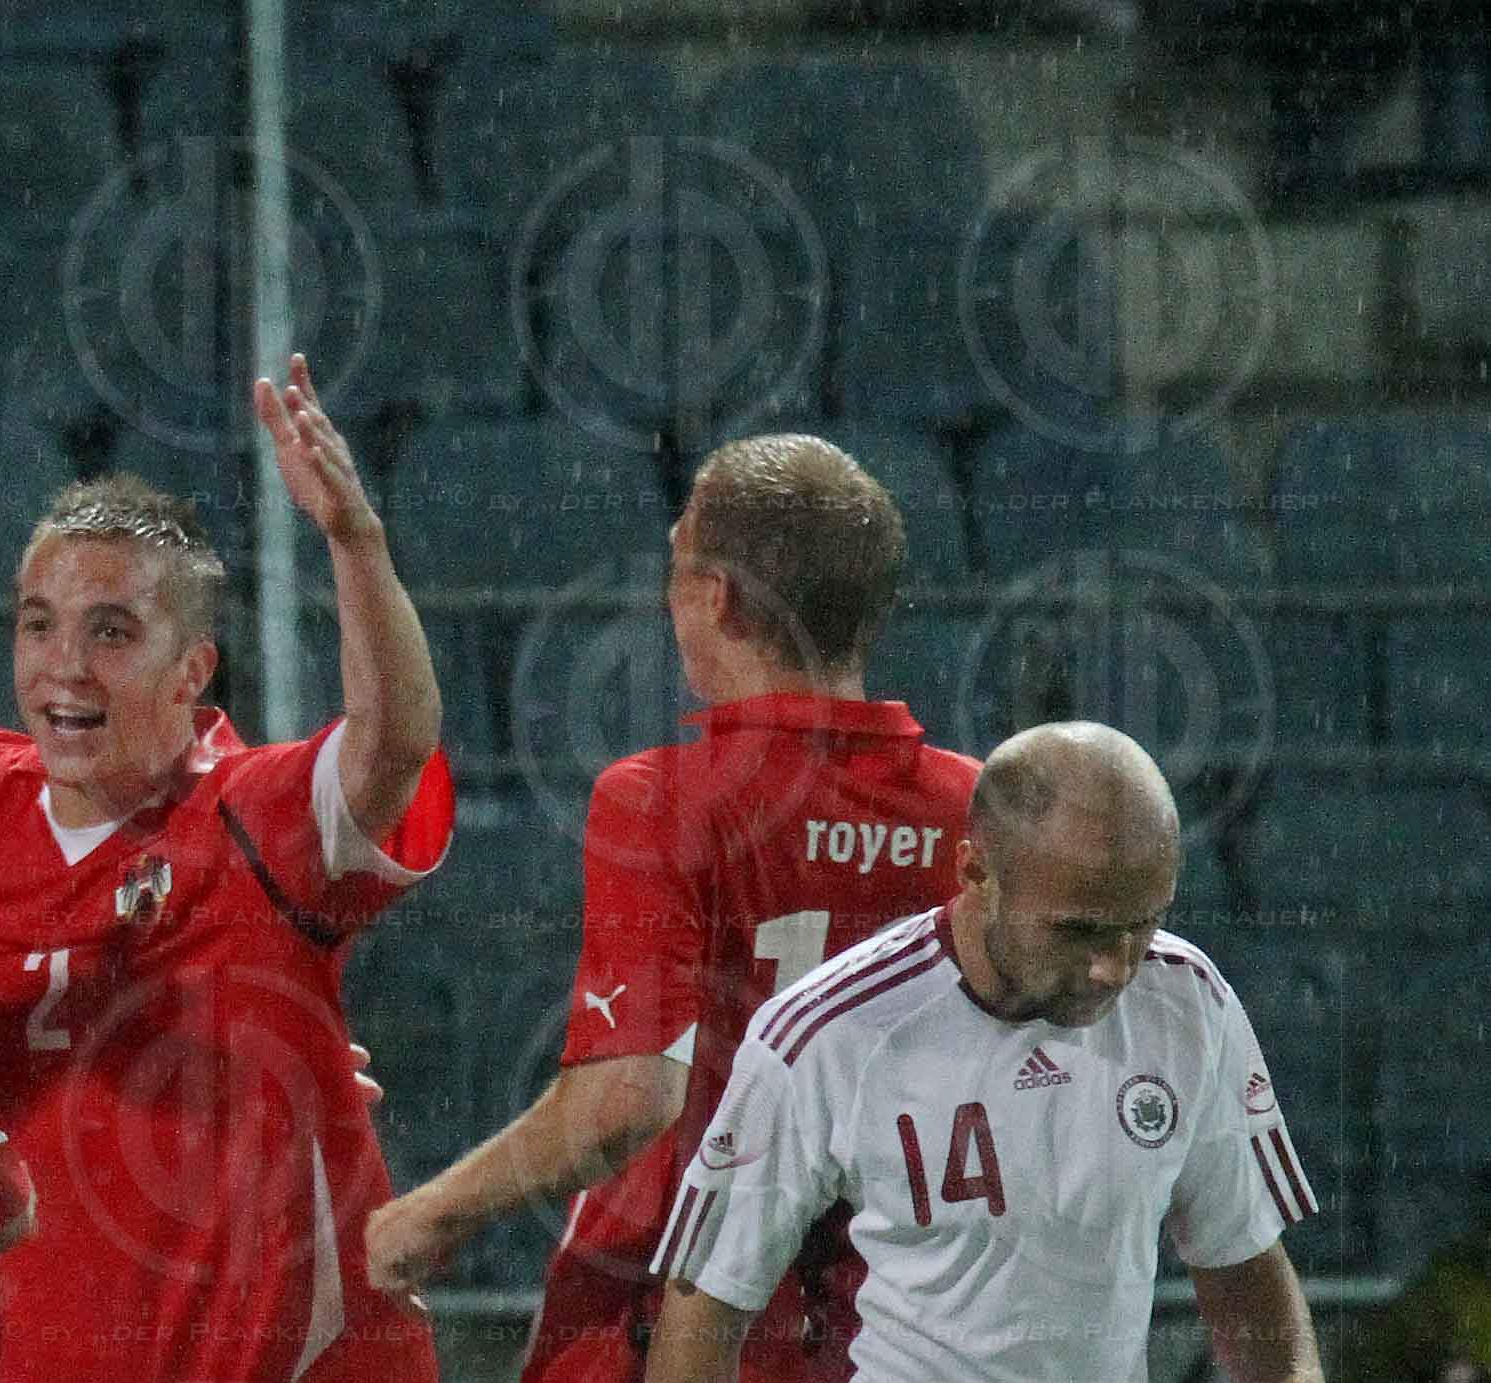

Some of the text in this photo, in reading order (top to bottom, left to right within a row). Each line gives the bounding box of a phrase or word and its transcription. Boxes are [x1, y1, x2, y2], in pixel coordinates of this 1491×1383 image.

[806, 820, 943, 874] royer
[23, 948, 71, 1050] 2
[1013, 1071, 1072, 1090] adidas
[896, 1101, 1007, 1228] 14
